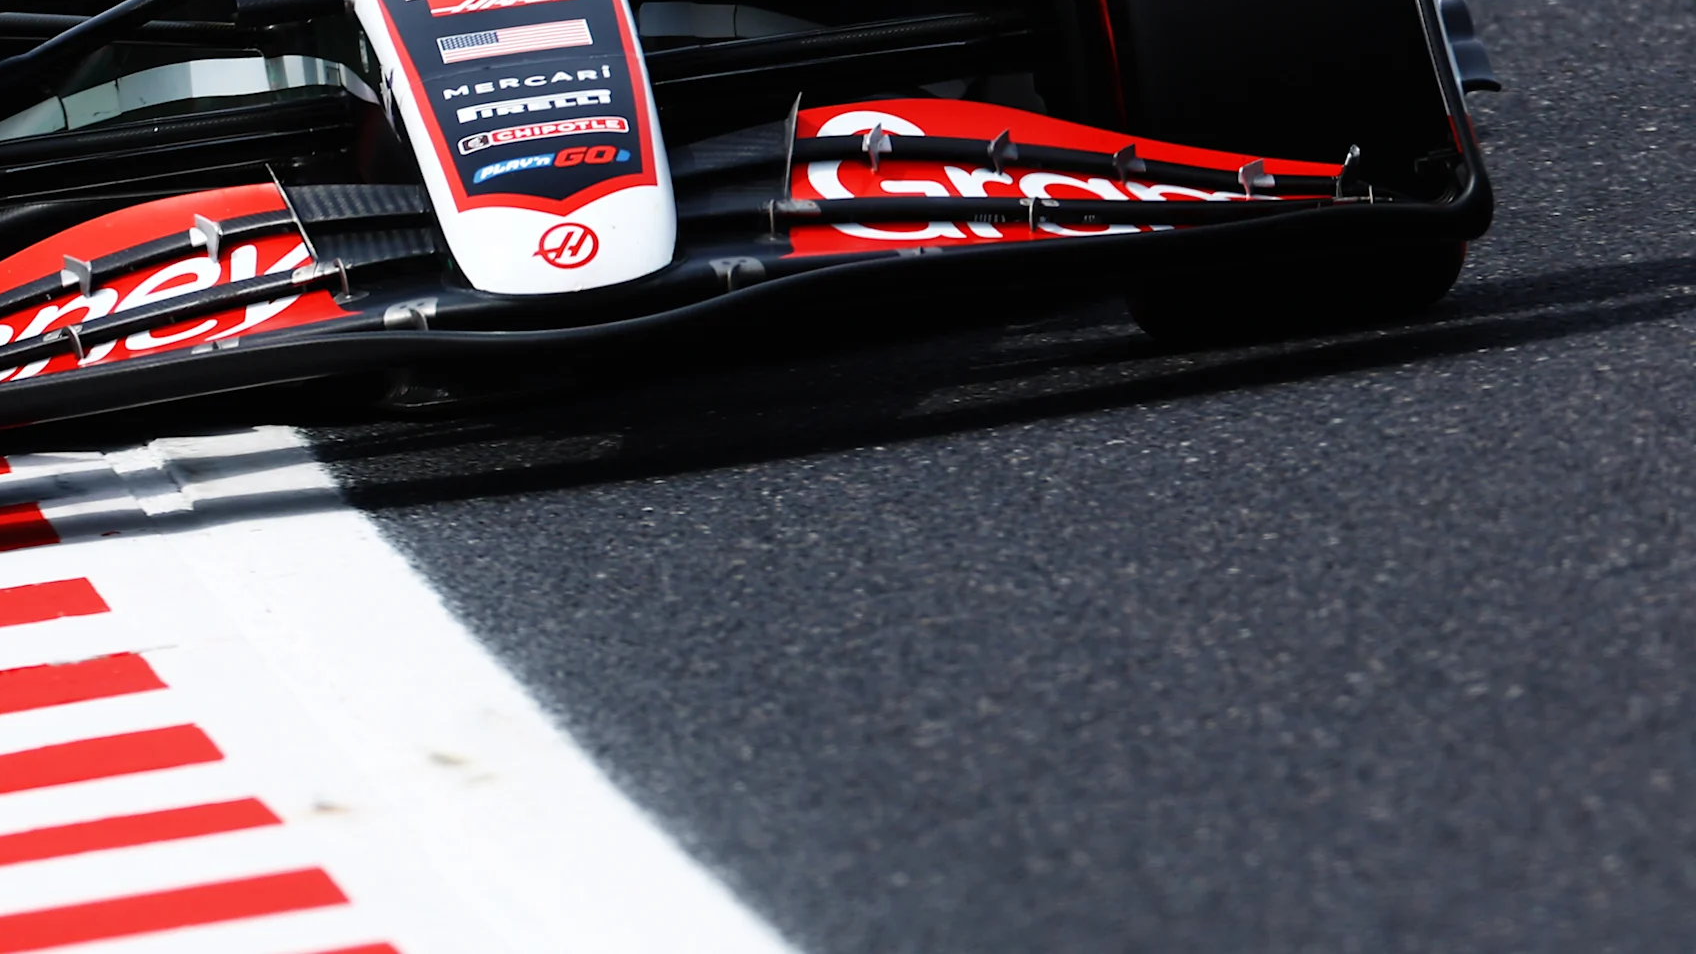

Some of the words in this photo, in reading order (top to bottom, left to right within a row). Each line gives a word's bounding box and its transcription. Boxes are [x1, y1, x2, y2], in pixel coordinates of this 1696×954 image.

[455, 88, 612, 124] PIRELLI
[495, 118, 621, 142] CHIPOTLE
[553, 145, 618, 168] GO
